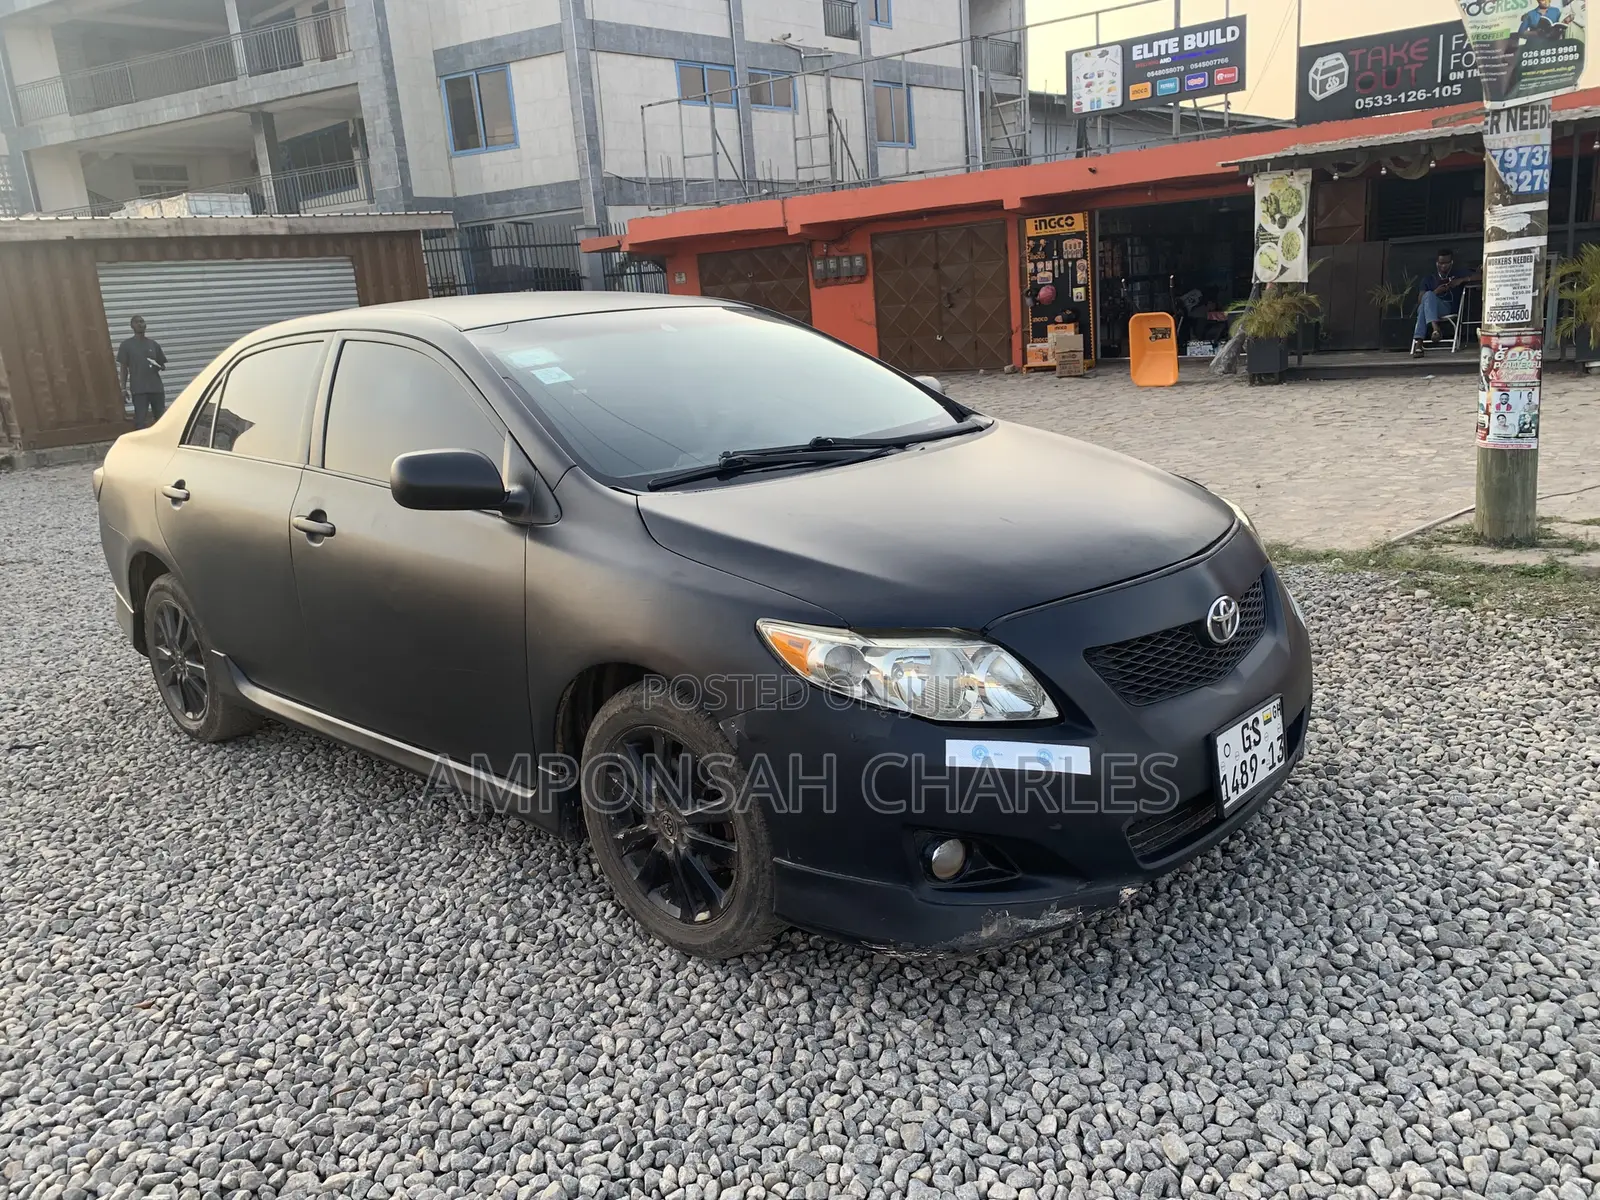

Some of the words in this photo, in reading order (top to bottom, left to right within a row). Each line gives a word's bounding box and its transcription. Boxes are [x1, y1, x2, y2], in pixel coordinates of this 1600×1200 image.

[1132, 37, 1180, 61] ELITE
[1183, 25, 1240, 51] BUILD
[1348, 38, 1430, 72] TAKE
[1522, 50, 1539, 58] 026
[1355, 62, 1424, 94] OUT
[1449, 71, 1465, 81] ON
[1355, 84, 1462, 110] 0533-126-105
[1499, 168, 1550, 193] 8279
[1488, 256, 1513, 266] WORKERS
[1512, 254, 1534, 264] NEEDED
[1487, 309, 1530, 323] 0596624600
[1507, 349, 1542, 361] DAYS
[1241, 717, 1262, 753] GS
[1221, 734, 1285, 802] 1489-13
